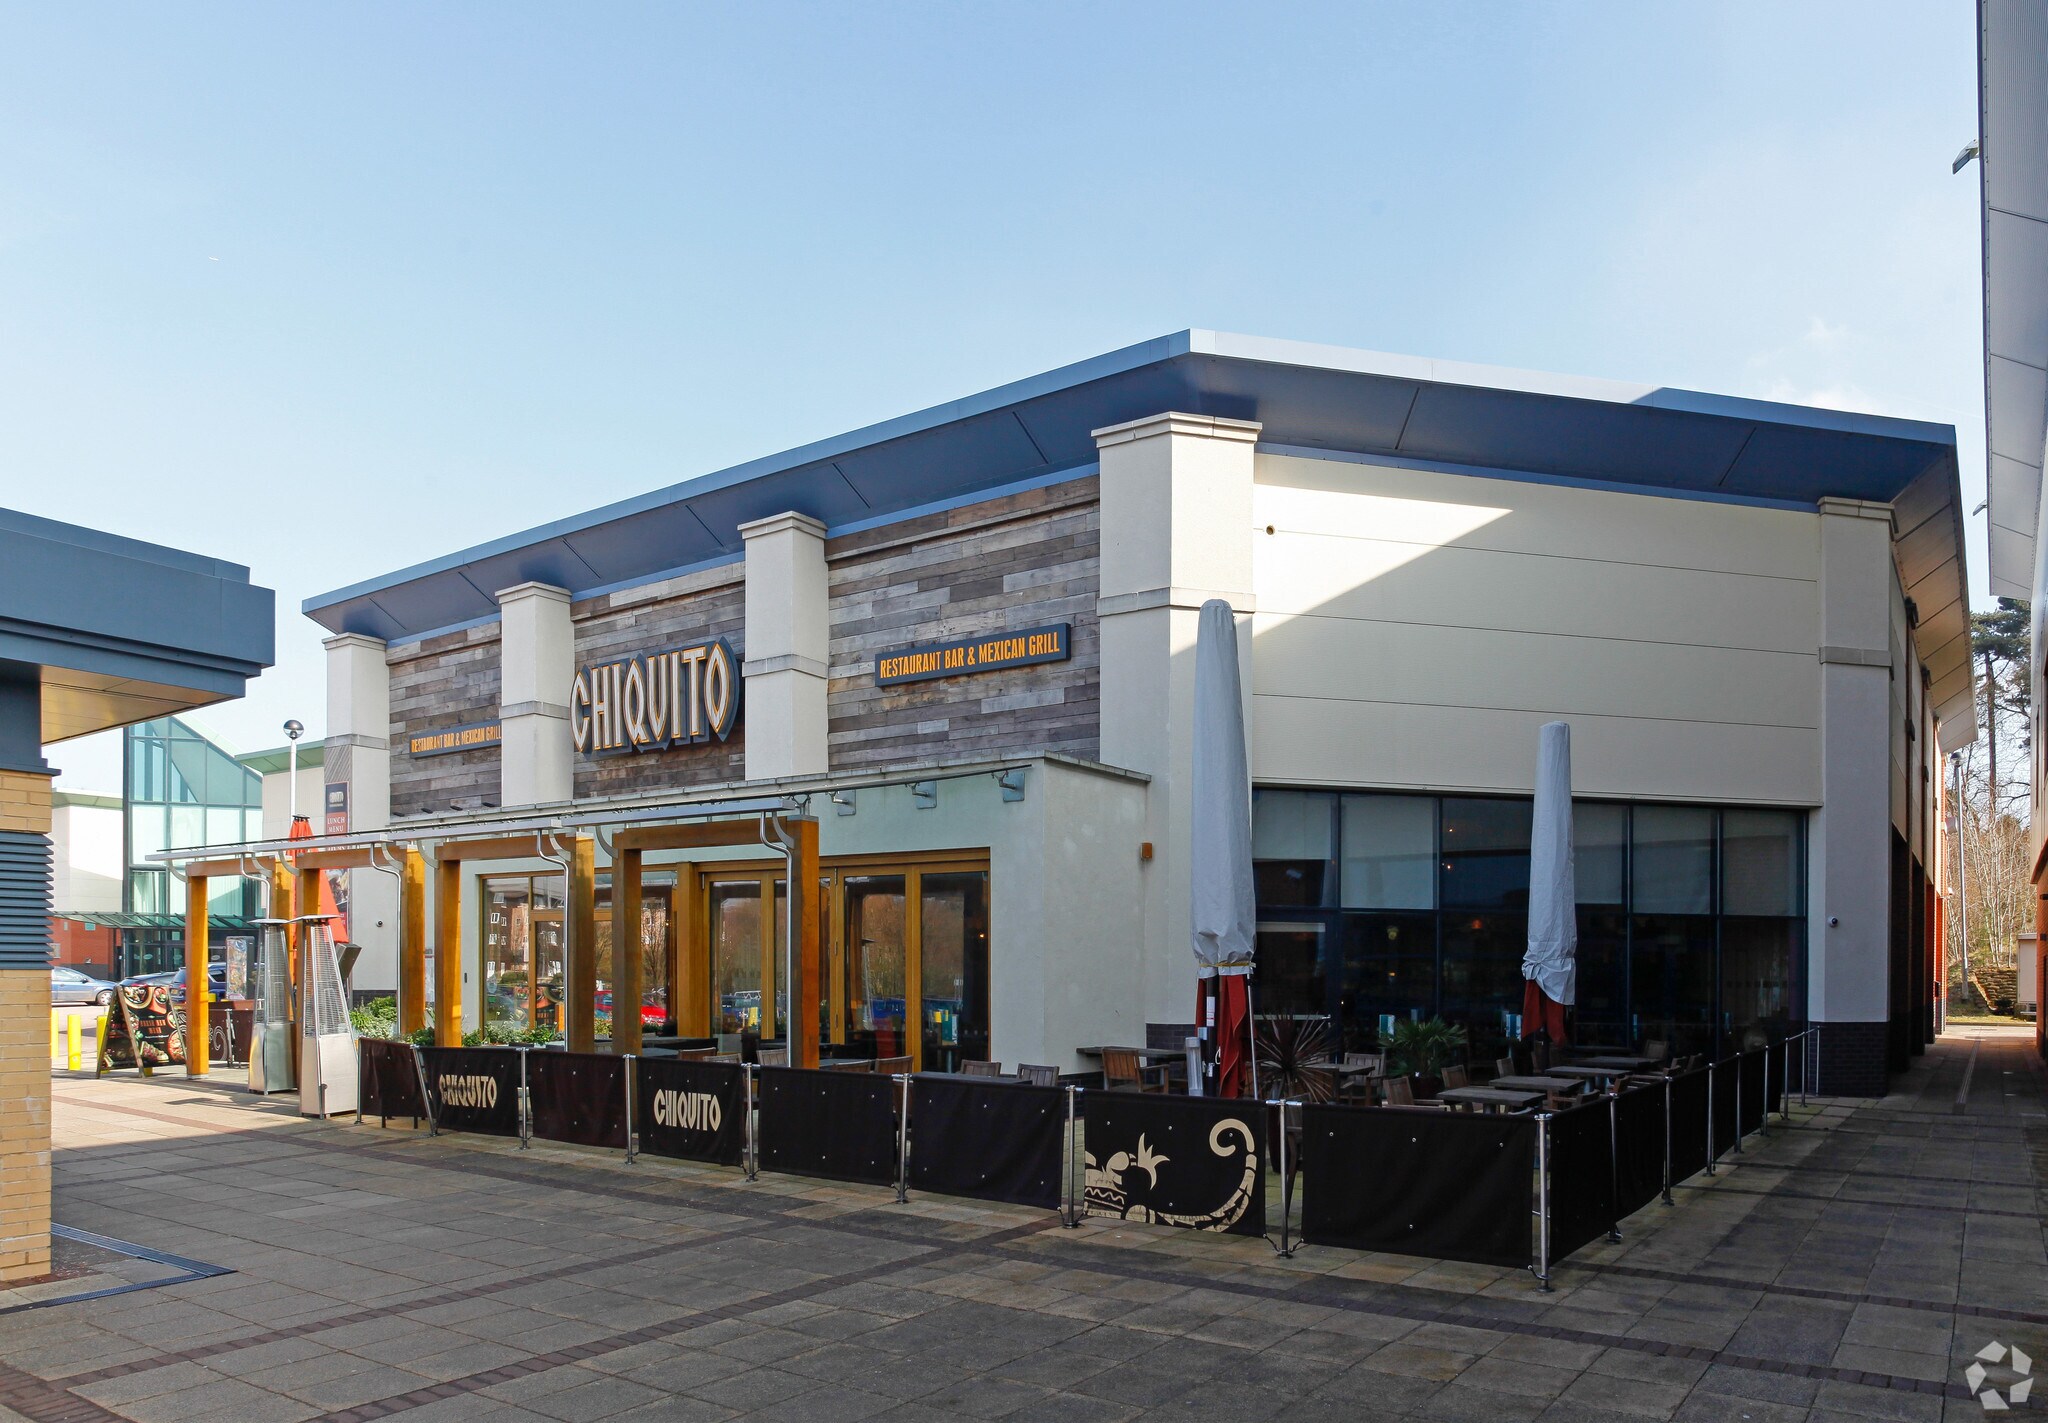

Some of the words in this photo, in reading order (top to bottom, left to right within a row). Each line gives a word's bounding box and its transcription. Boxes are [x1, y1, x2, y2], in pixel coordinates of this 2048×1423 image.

[879, 651, 942, 679] RESTAURANT
[944, 647, 965, 669] BAR
[967, 646, 976, 666] &
[978, 637, 1026, 664] MEXICAN
[1028, 631, 1060, 656] GRILL
[570, 641, 732, 752] CHIQUITO
[411, 735, 443, 753] RESTAURANT
[443, 732, 455, 748] BAR
[455, 732, 460, 746] &
[461, 727, 485, 745] MEXICAN
[485, 725, 501, 741] GRILL
[327, 816, 346, 825] LUNCH
[328, 825, 344, 834] MENU
[439, 1074, 498, 1109] CHIQUITO
[653, 1088, 722, 1132] CHIQUITO
